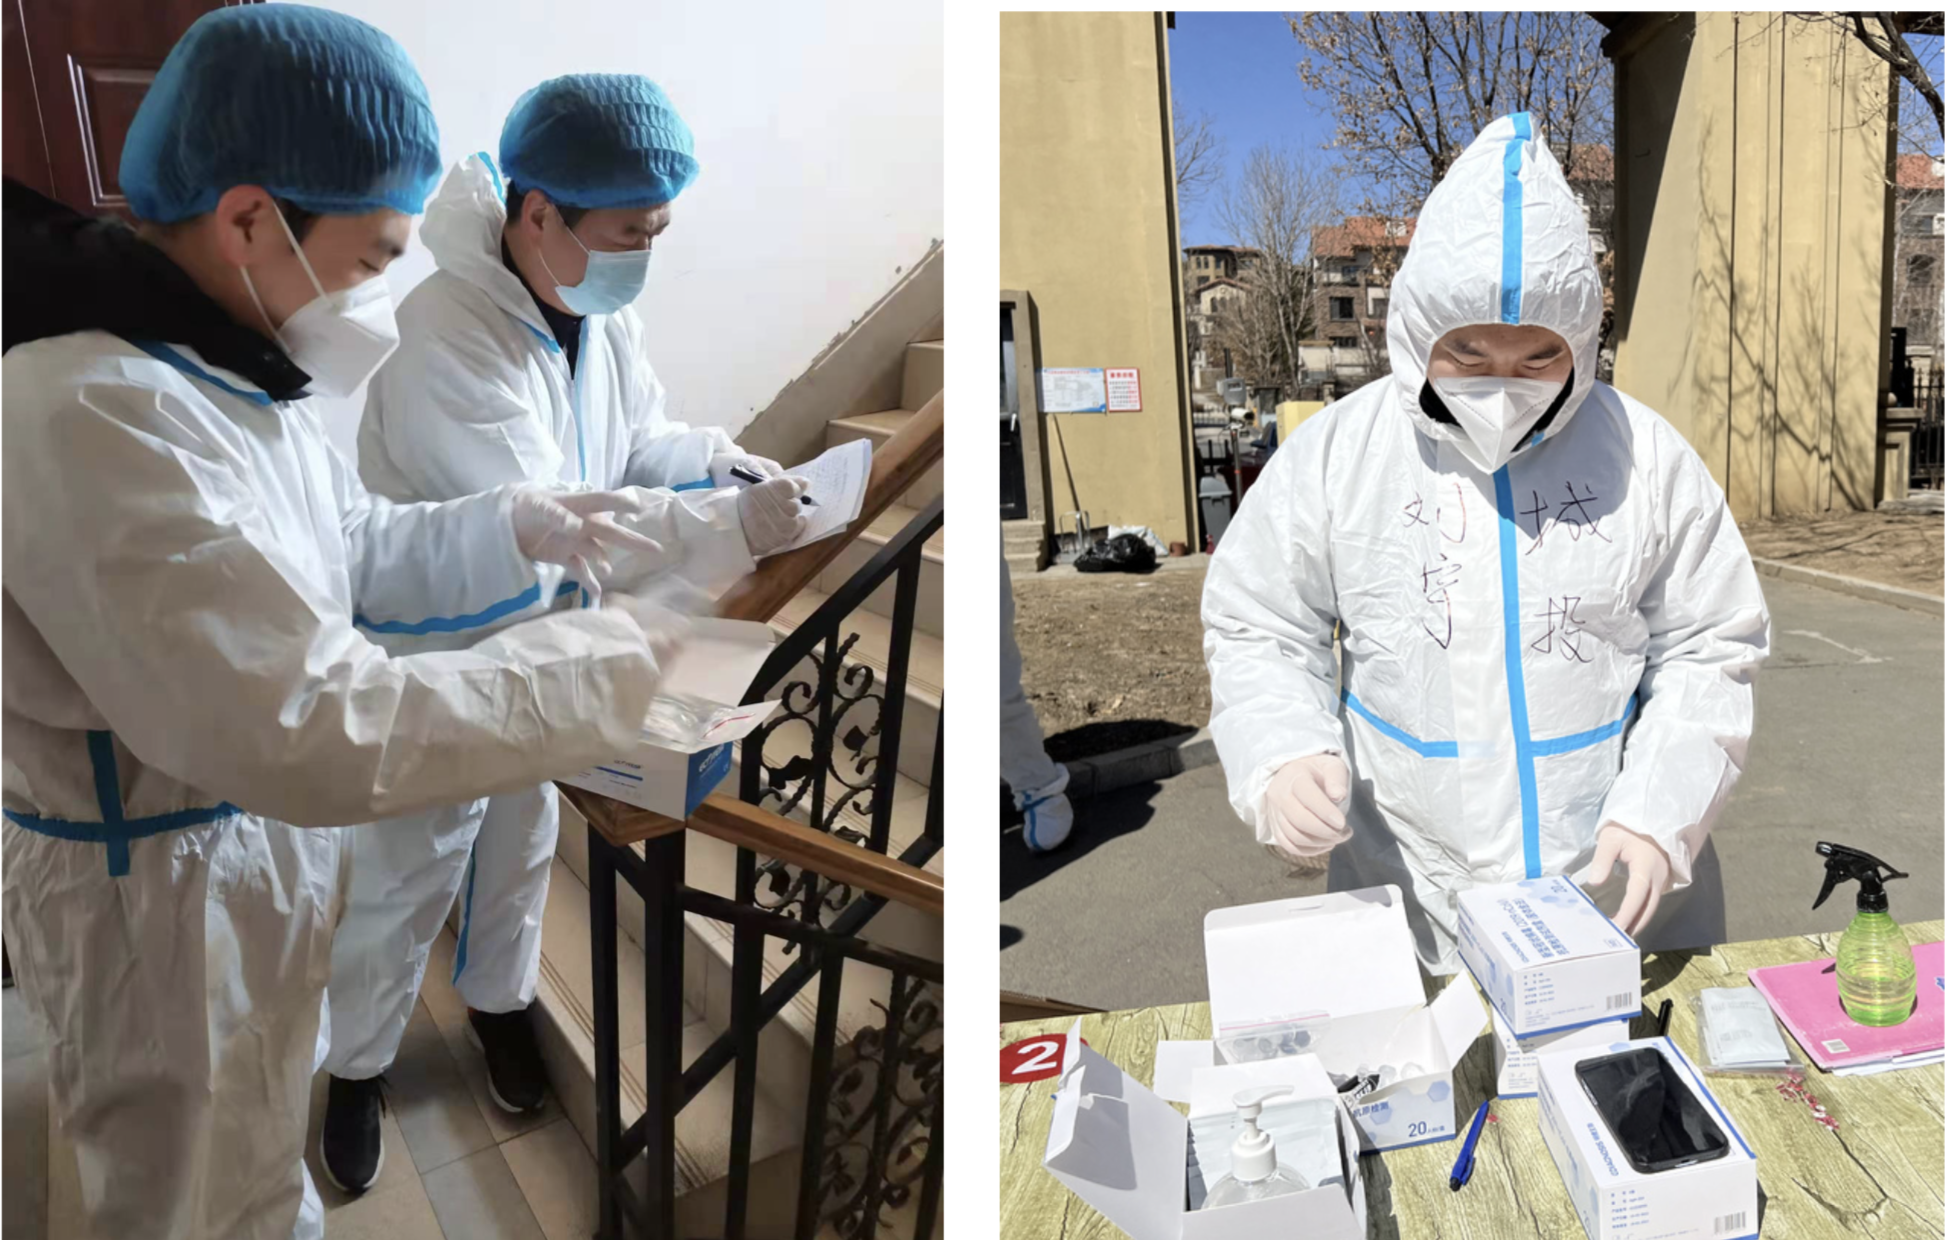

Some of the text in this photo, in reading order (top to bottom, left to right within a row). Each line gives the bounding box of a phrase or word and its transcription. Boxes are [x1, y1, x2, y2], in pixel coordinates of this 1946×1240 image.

[1519, 480, 1613, 664] 城投
[1011, 1040, 1059, 1075] 2
[1408, 1120, 1428, 1138] 20
